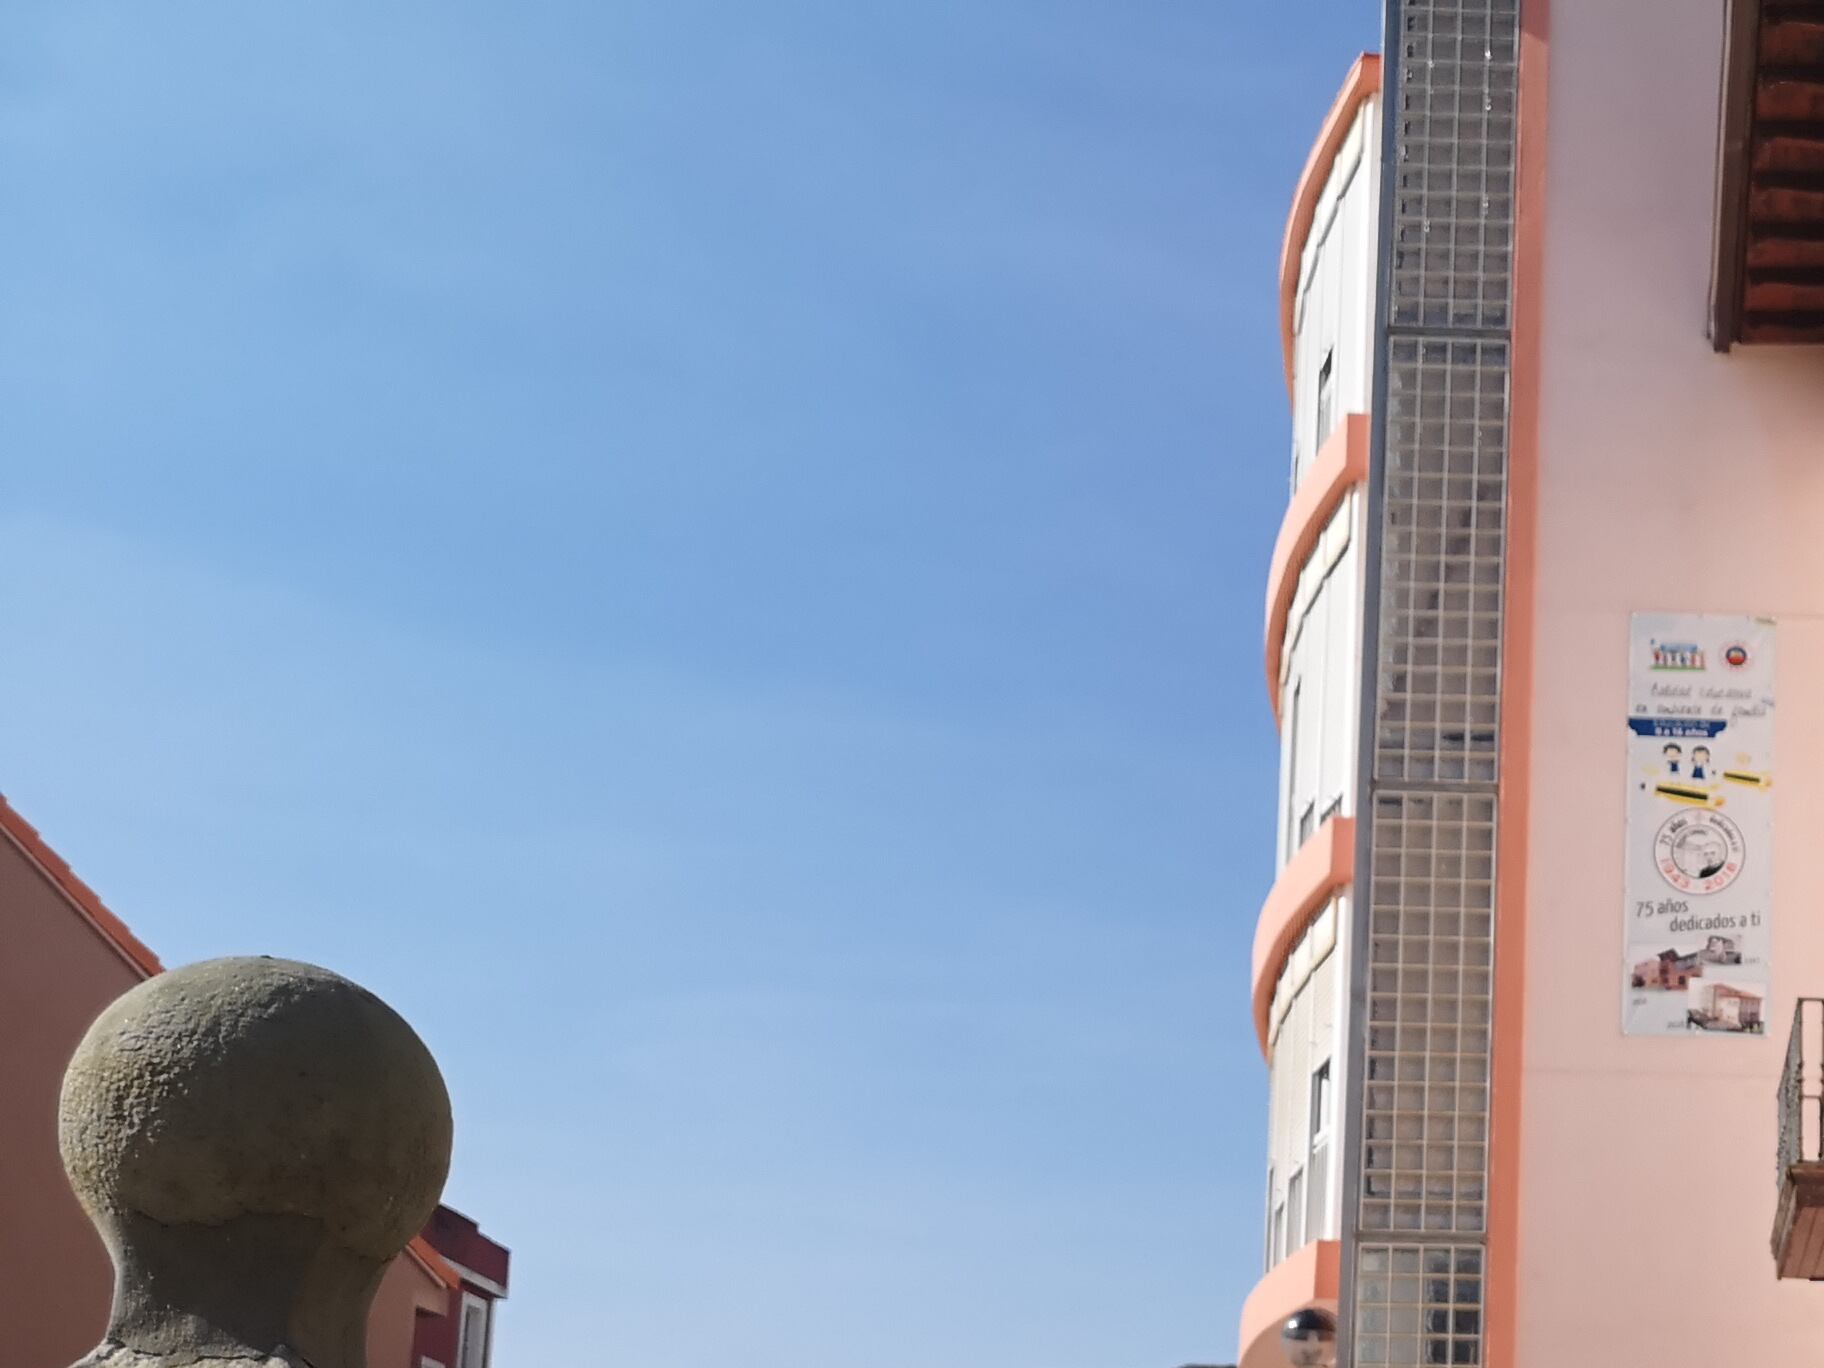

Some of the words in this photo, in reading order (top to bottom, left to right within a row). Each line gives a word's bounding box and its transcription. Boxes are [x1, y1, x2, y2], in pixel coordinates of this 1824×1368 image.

[1636, 900, 1655, 917] 75
[1657, 898, 1689, 914] años
[1669, 913, 1736, 932] dedicados
[1739, 914, 1748, 928] a
[1750, 910, 1761, 926] ti
